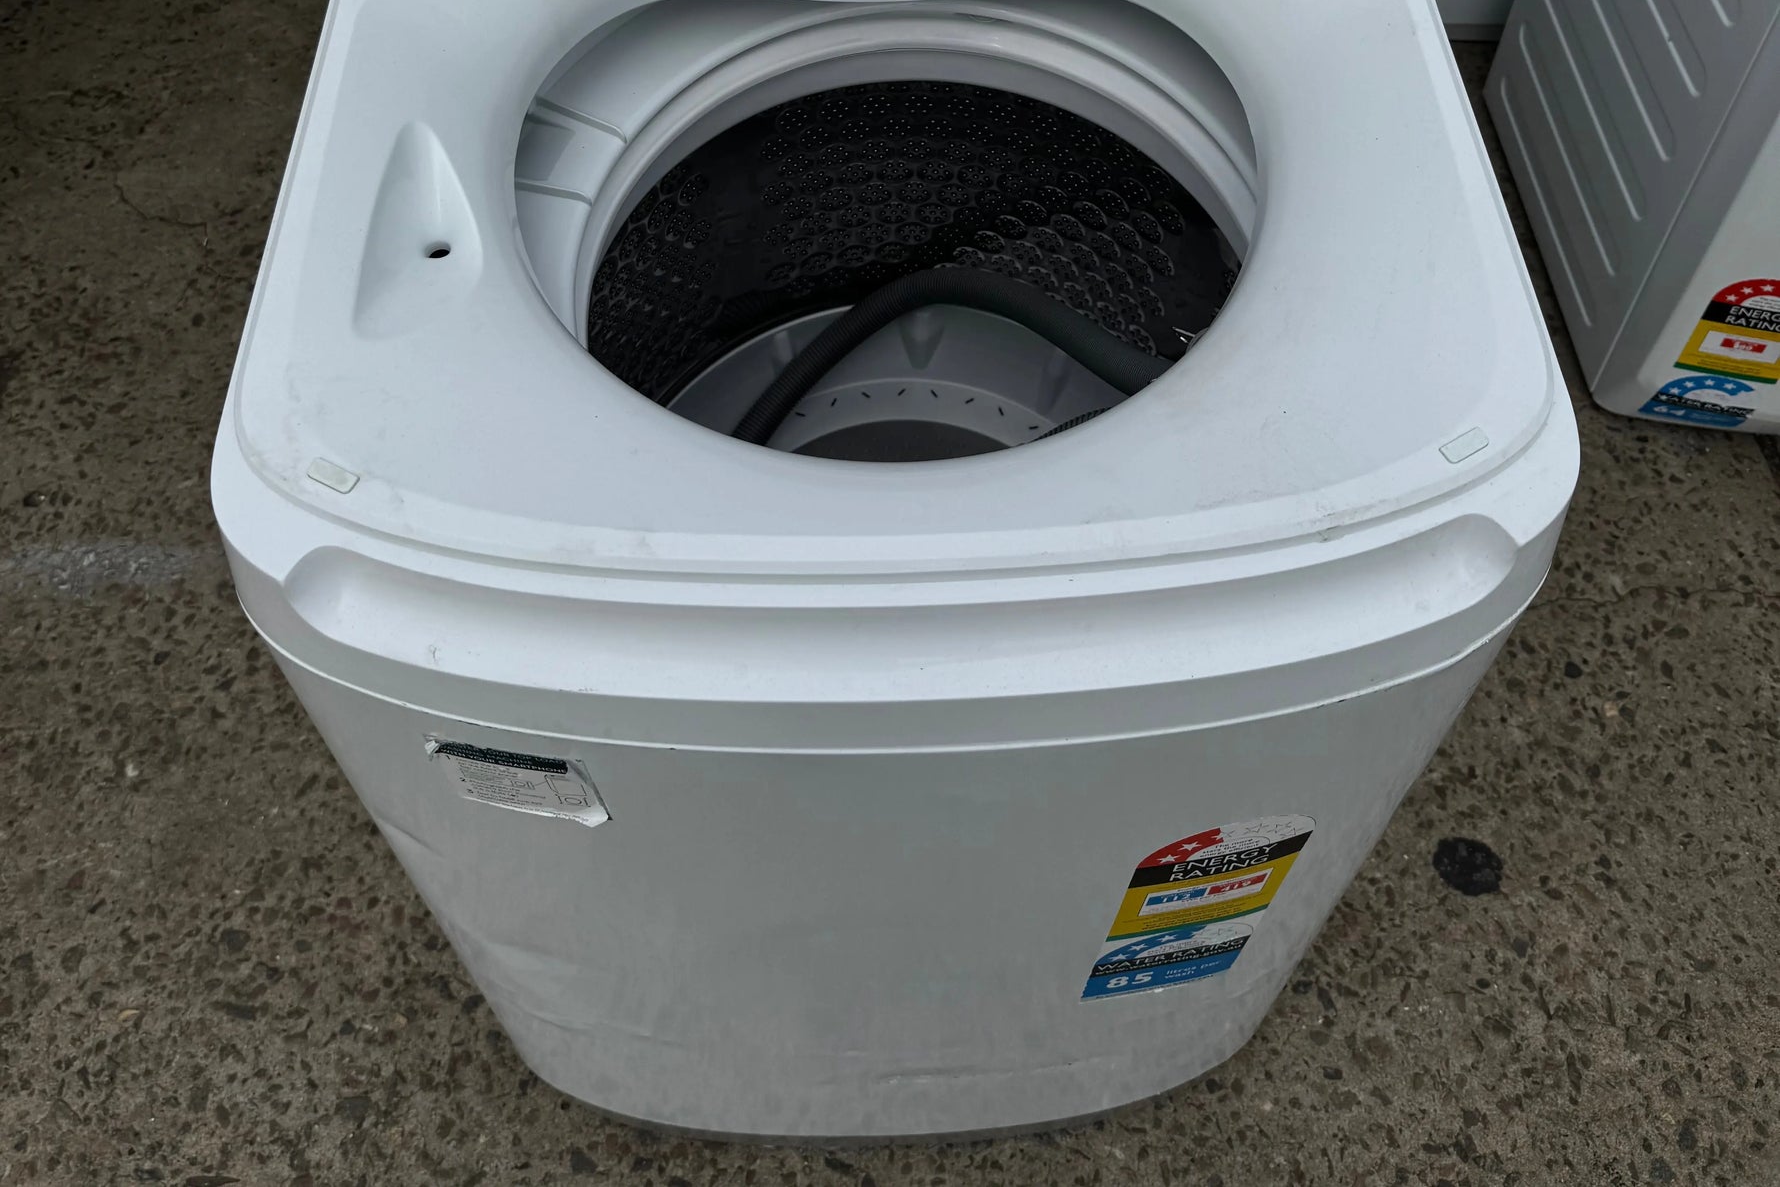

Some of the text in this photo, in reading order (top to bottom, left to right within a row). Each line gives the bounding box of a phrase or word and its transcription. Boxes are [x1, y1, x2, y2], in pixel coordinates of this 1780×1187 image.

[1729, 306, 1780, 322] ENERG
[468, 754, 494, 762] YOUR
[496, 759, 566, 774] SMARTPHONE
[1172, 843, 1278, 873] ENERGY
[1169, 854, 1270, 881] RATING
[1097, 955, 1167, 971] WATER
[1172, 939, 1244, 956] RATING
[1164, 970, 1195, 979] wash
[1166, 960, 1221, 975] litres per
[1107, 972, 1154, 988] 85
